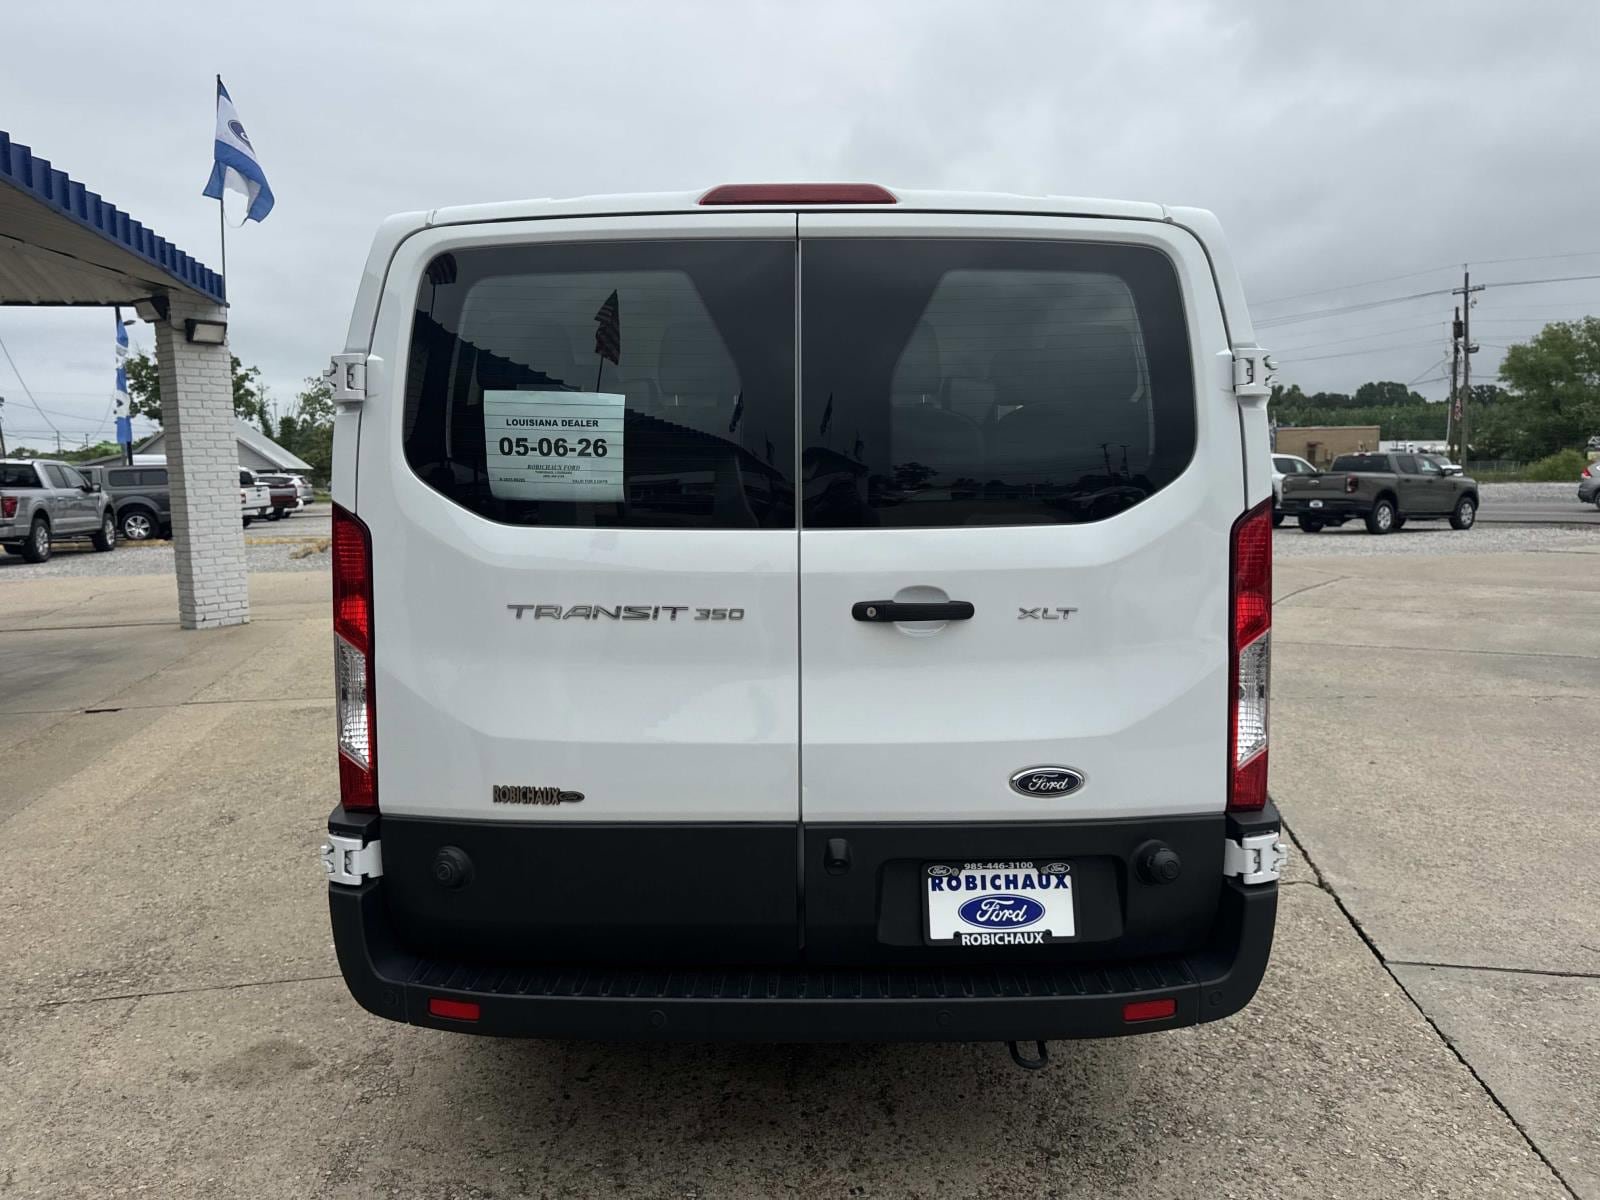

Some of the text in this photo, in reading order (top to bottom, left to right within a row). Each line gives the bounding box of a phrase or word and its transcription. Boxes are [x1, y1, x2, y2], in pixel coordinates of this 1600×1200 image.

[506, 418, 599, 428] LOUISIANA DEALER
[499, 437, 608, 458] 05-06-26
[507, 604, 745, 621] TRANSIT 350
[1017, 607, 1079, 620] XLT
[1028, 774, 1069, 791] Ford
[493, 785, 560, 805] ROBICHAUX
[964, 861, 1033, 870] 985-446-3100
[931, 874, 1069, 892] ROBICHAUX
[976, 898, 1027, 922] Ford
[961, 932, 1044, 946] ROBICHAUX
